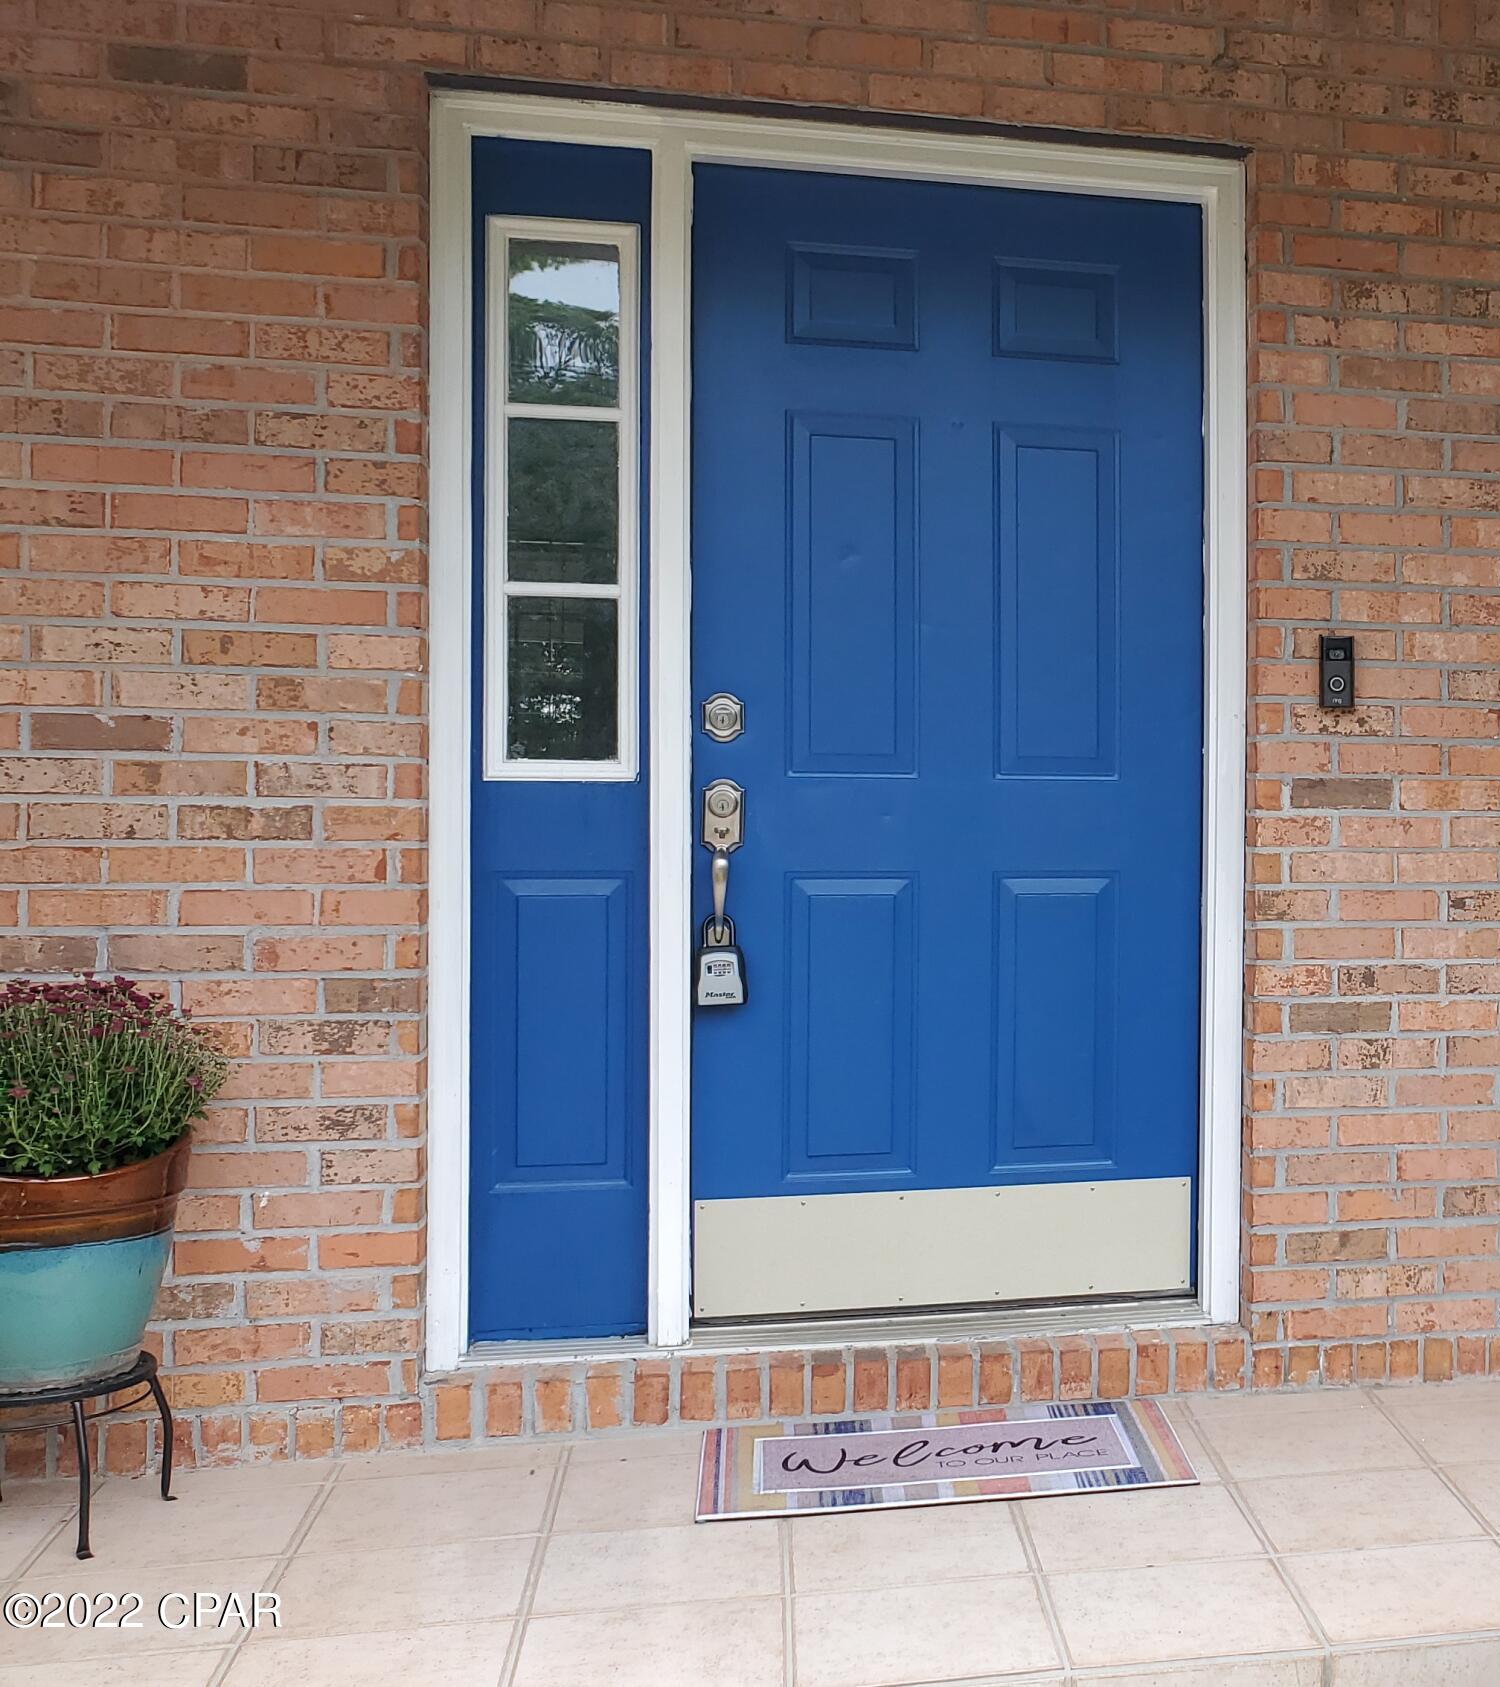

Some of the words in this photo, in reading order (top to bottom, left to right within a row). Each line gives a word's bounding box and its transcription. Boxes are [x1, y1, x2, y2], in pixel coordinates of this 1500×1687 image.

[781, 1435, 1097, 1474] Welcome
[936, 1459, 966, 1469] TO
[974, 1455, 1024, 1466] OUR
[1036, 1448, 1109, 1461] PLACE
